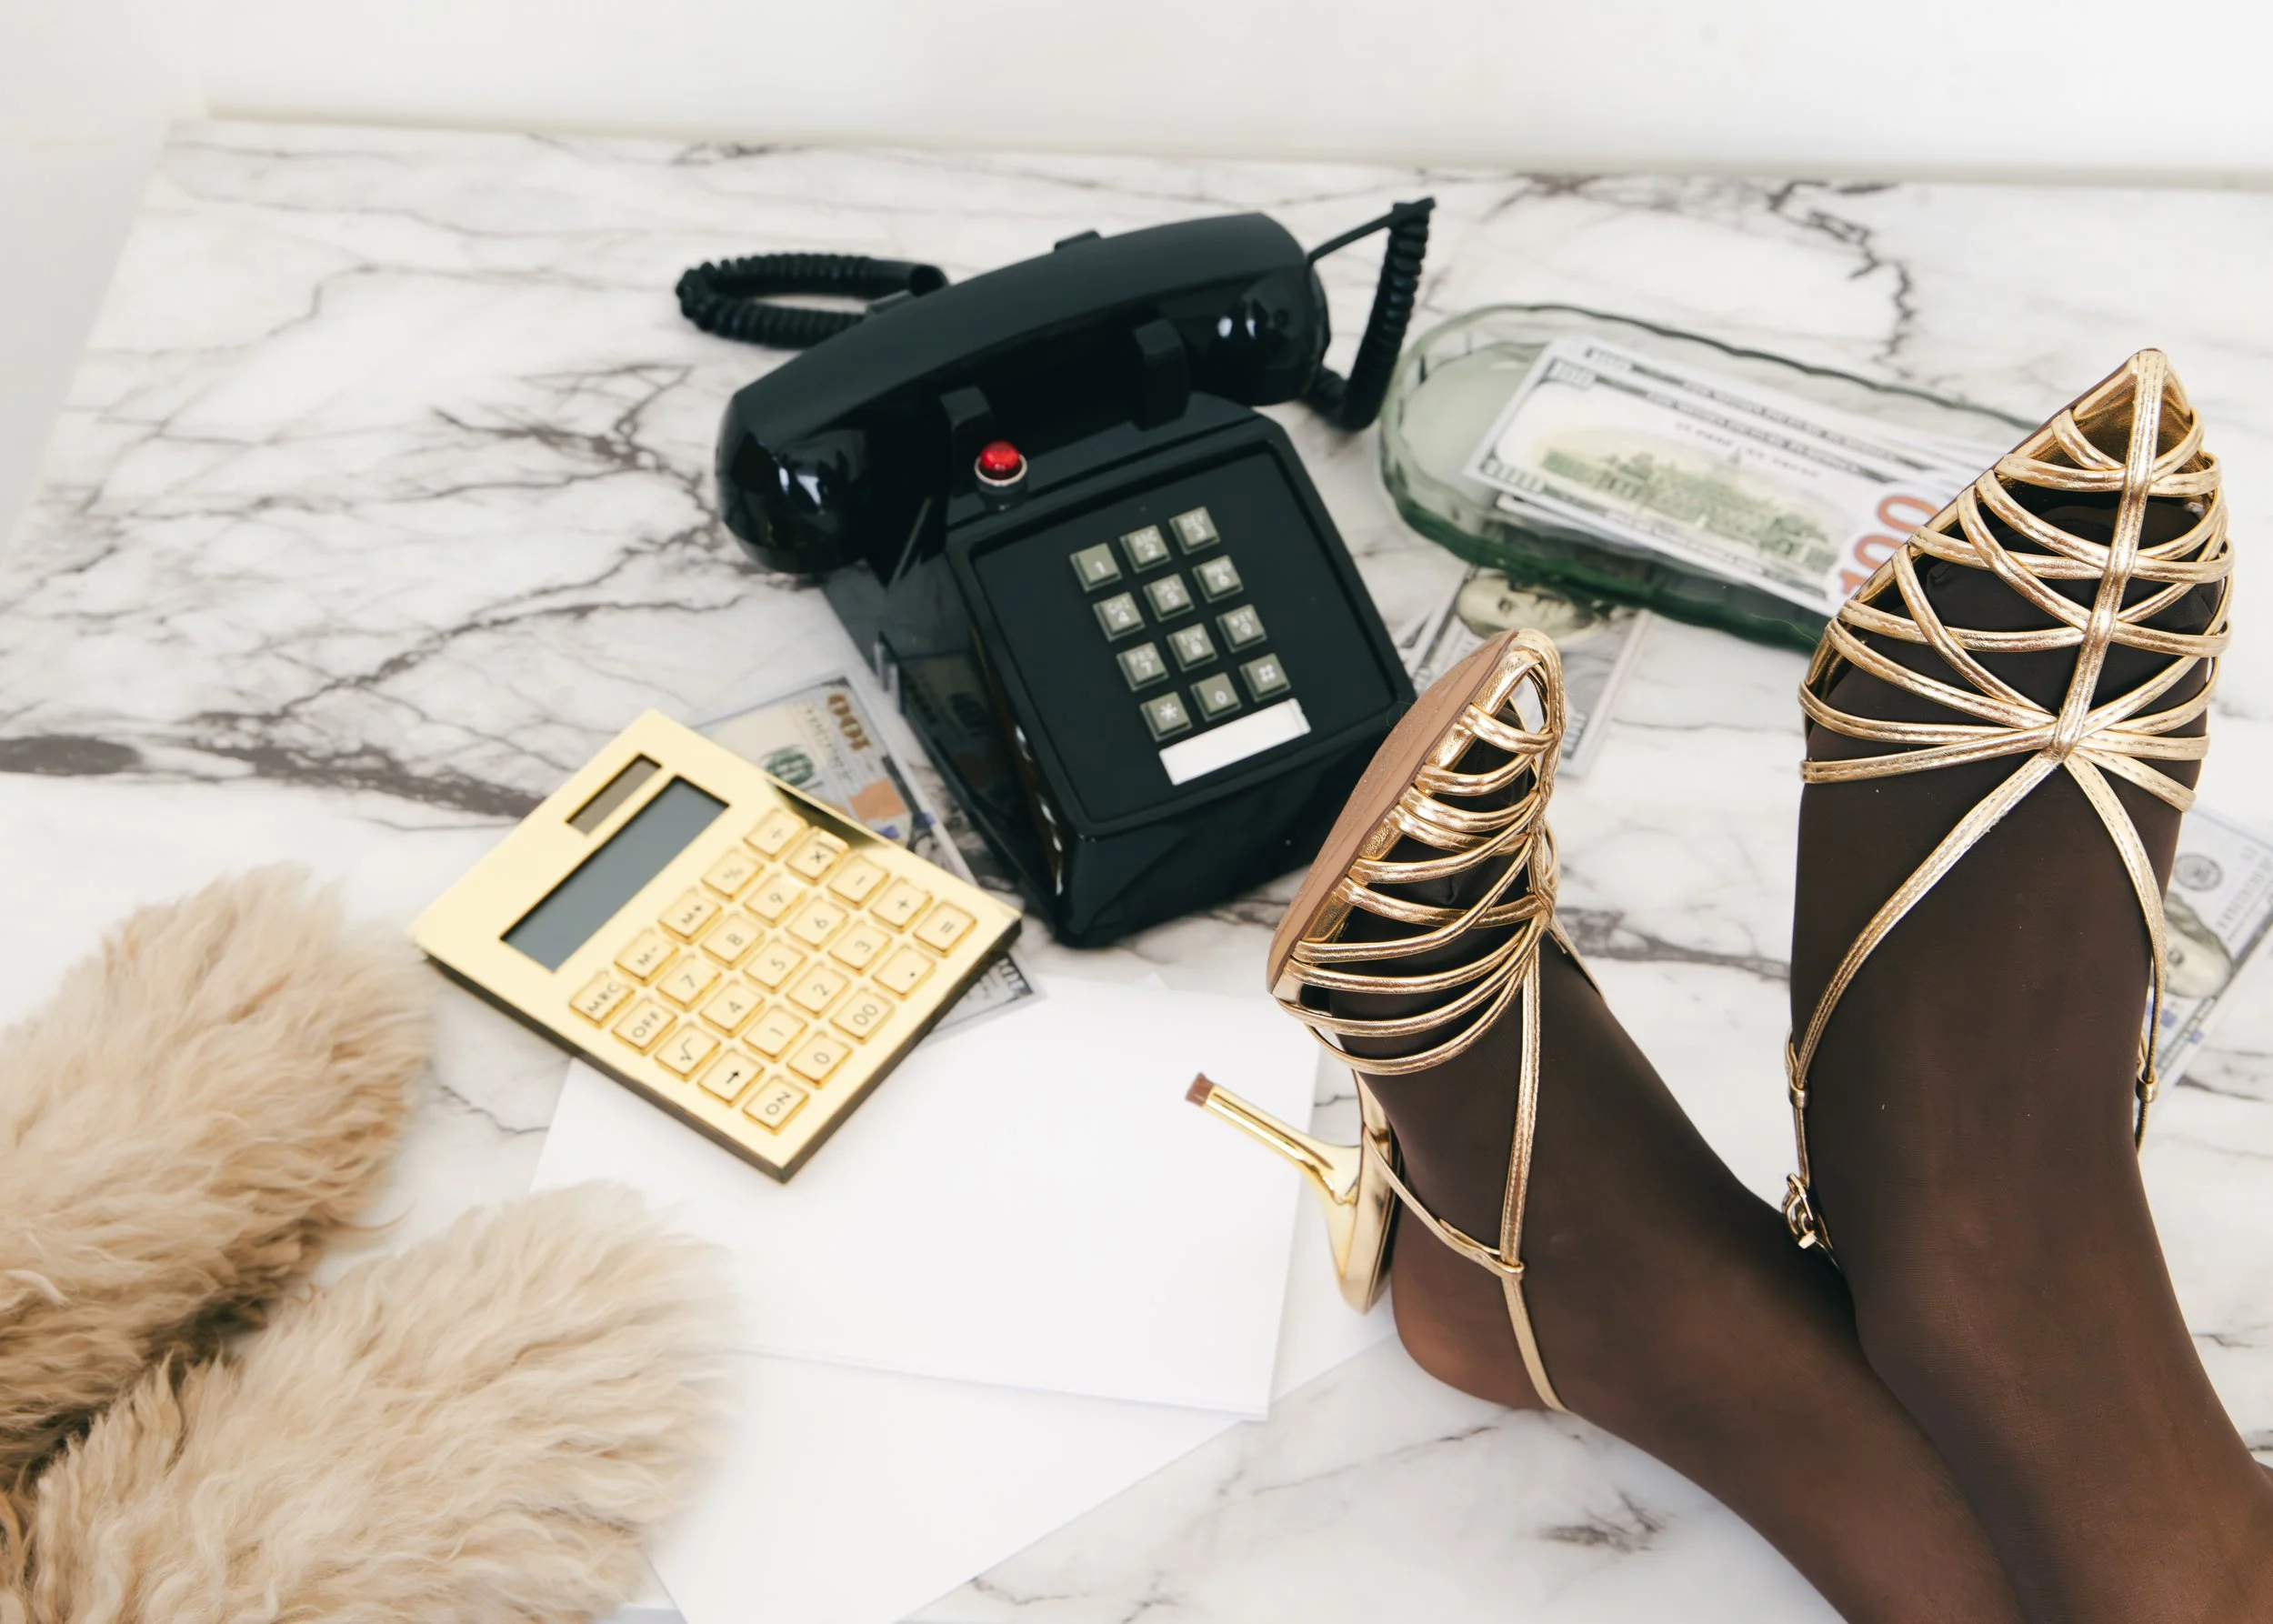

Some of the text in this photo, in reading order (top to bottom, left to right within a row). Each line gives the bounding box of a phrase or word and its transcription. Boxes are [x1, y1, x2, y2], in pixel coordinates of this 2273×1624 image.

[1144, 543, 1157, 558] 2
[1095, 560, 1106, 575] 1
[1140, 660, 1153, 676] 7
[1215, 689, 1228, 706] 0
[828, 694, 870, 750] 100
[768, 891, 784, 904] 9
[813, 916, 829, 930] 6
[726, 933, 744, 947] 8
[854, 939, 872, 953] 3
[770, 957, 786, 972] 5
[680, 973, 696, 988] 7
[811, 982, 831, 997] 2
[727, 999, 744, 1014] 4
[852, 1003, 879, 1027] 00
[631, 1009, 661, 1038] OFF
[813, 1051, 831, 1067] 0
[765, 1091, 792, 1117] ON
